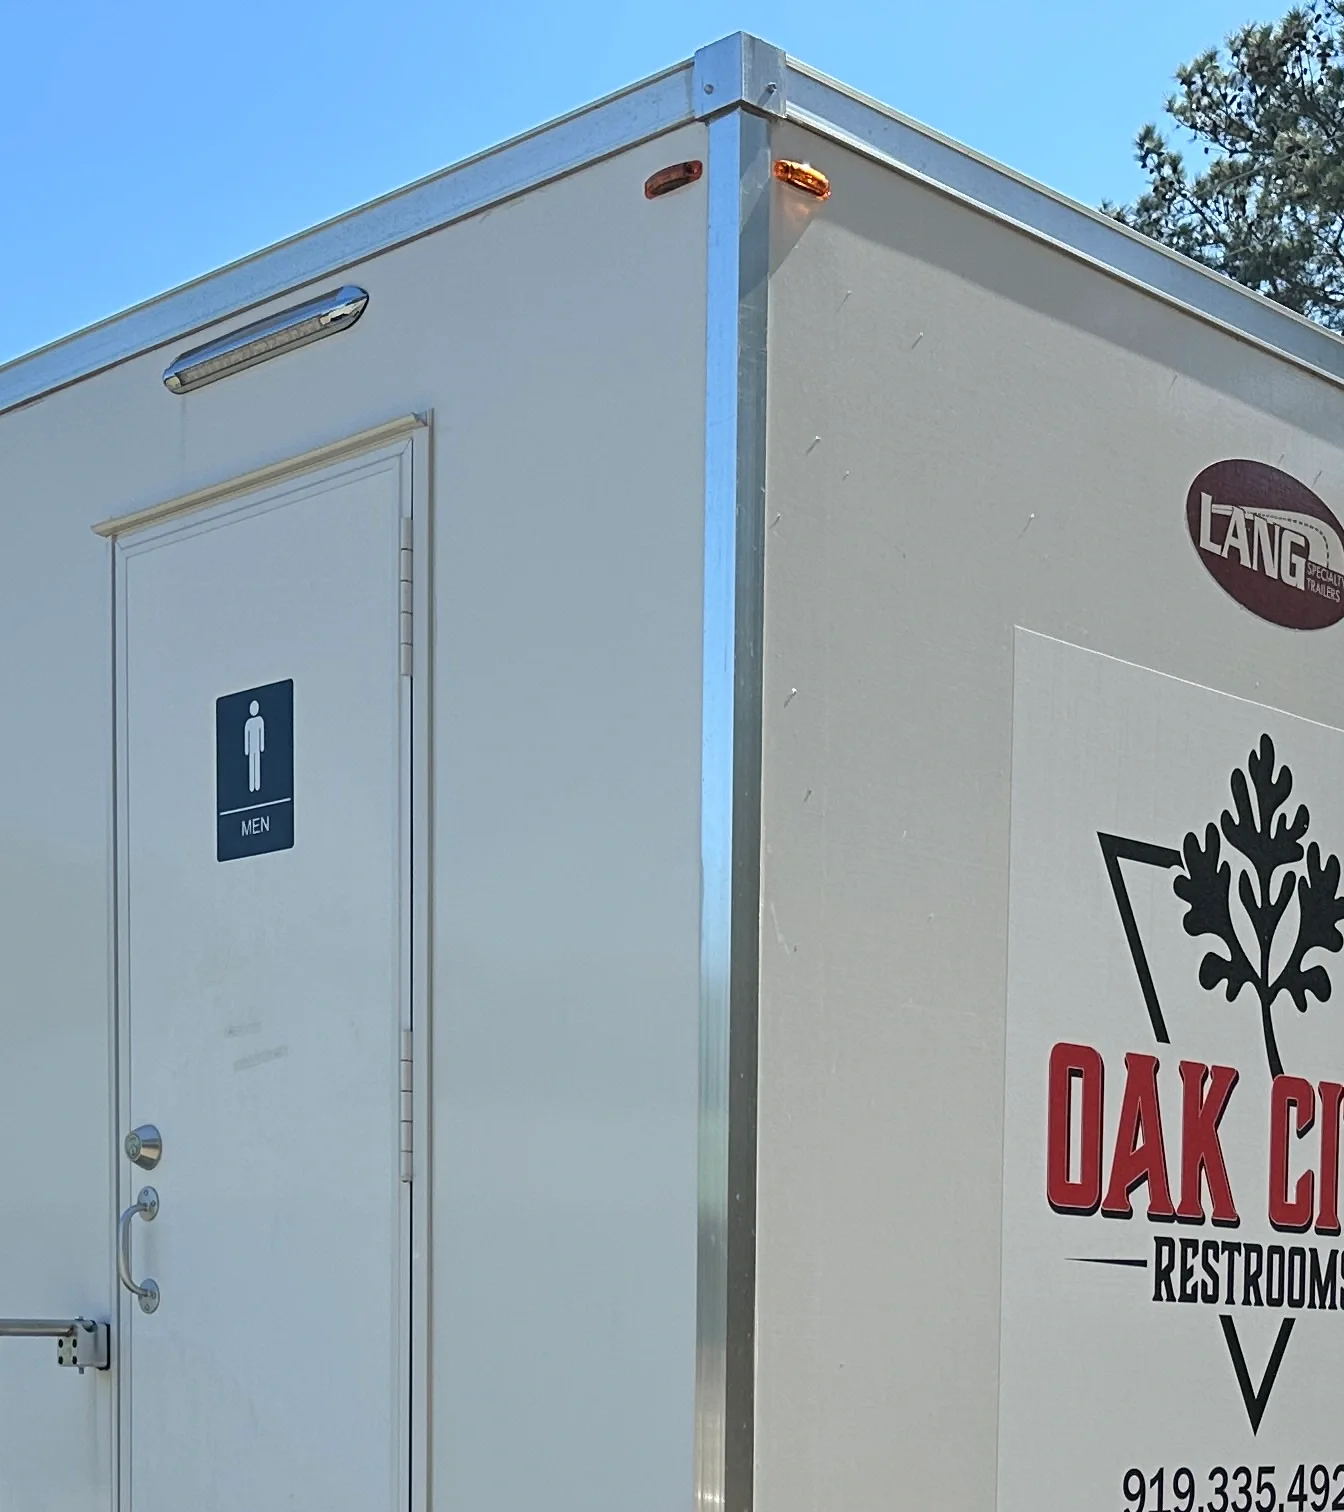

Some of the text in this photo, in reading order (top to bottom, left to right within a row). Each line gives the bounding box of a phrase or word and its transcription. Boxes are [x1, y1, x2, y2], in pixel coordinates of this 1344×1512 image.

[1199, 491, 1306, 591] LANG
[1306, 577, 1341, 603] TRAILERS
[241, 815, 271, 837] MEN
[1046, 1041, 1240, 1229] OAK
